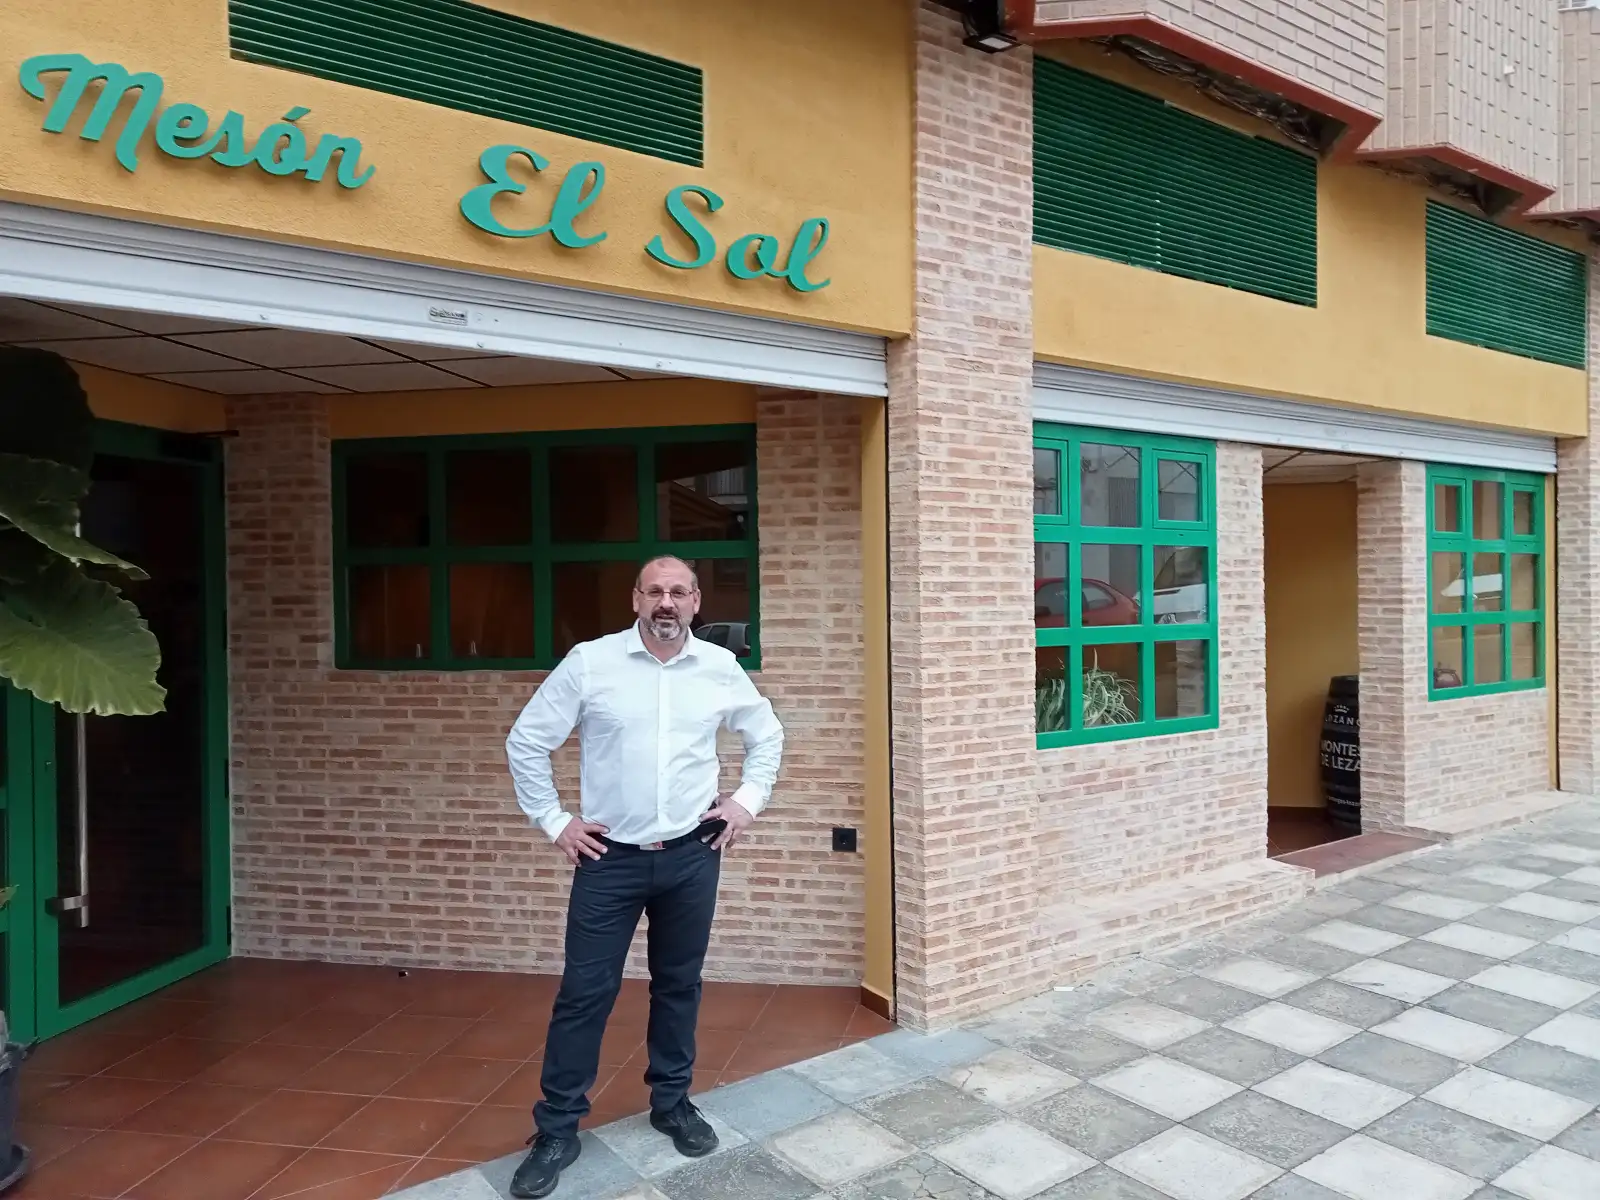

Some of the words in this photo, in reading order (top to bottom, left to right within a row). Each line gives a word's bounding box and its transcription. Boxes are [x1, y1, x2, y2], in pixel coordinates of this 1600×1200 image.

[19, 53, 376, 189] Mesón
[460, 144, 607, 249] El
[644, 184, 831, 292] Sol
